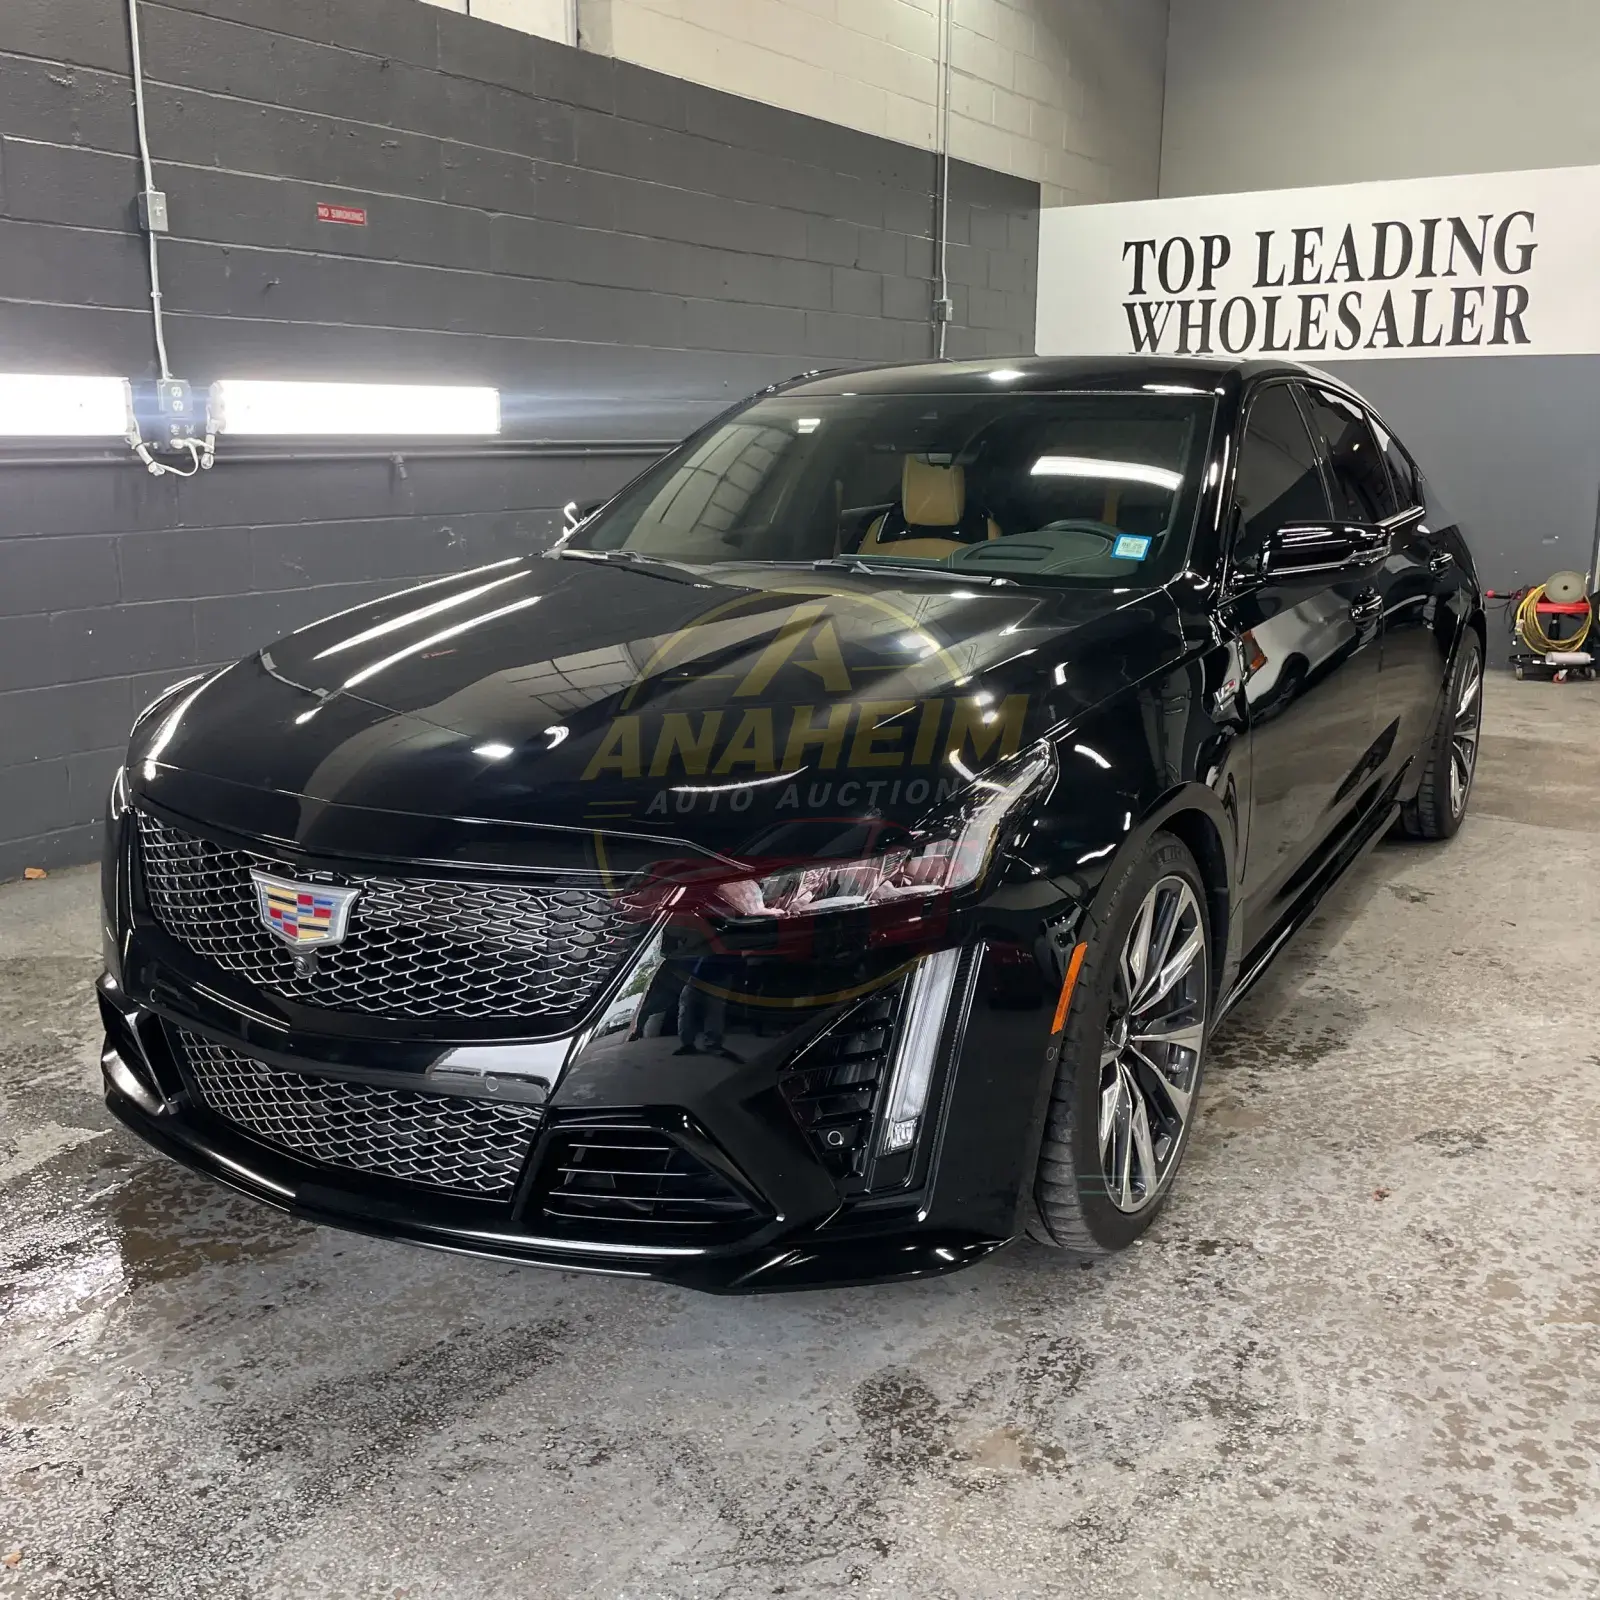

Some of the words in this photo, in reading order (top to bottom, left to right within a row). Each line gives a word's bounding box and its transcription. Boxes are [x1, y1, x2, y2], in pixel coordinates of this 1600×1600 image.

[318, 206, 330, 218] NO
[1122, 234, 1231, 296] TOP
[1252, 210, 1538, 288] LEADING
[1122, 284, 1531, 354] WHOLESALER
